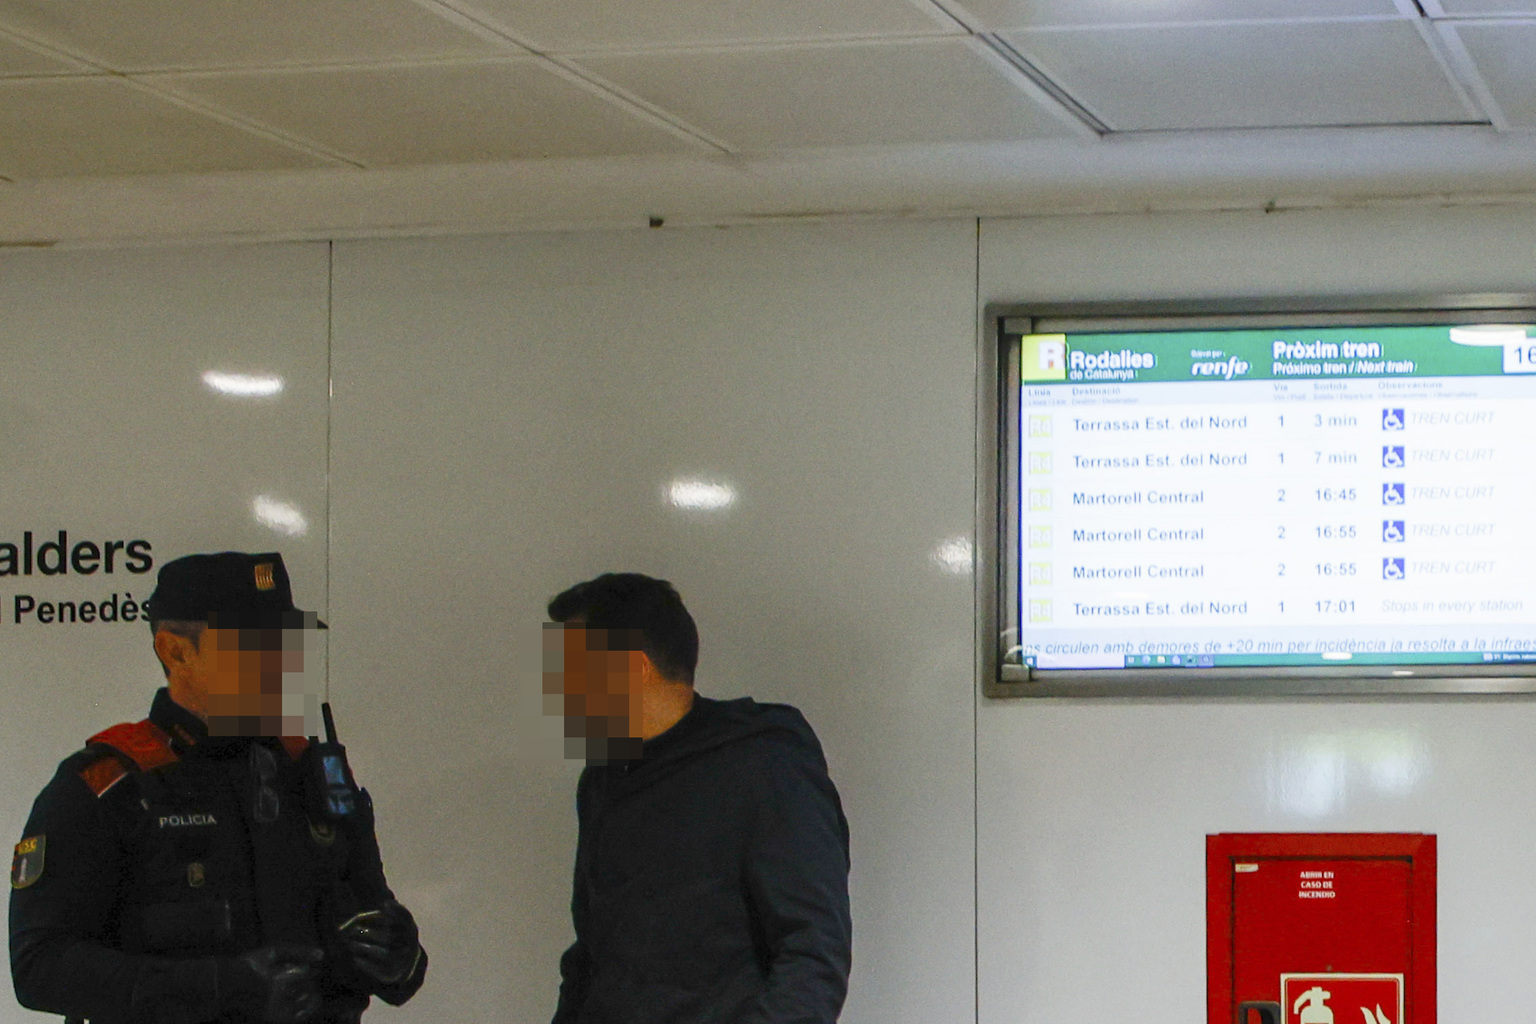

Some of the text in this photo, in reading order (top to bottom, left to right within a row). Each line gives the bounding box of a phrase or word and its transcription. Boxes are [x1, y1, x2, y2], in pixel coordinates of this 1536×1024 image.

[1070, 349, 1154, 369] Rodalies
[1272, 341, 1381, 359] Pròxim tren
[1070, 369, 1135, 381] de Catalunya
[1191, 355, 1249, 380] renfe
[1272, 361, 1322, 376] Próximo
[1324, 362, 1347, 375] tren
[1356, 361, 1385, 374] Next
[1386, 361, 1414, 374] train
[1073, 418, 1140, 431] Terrassa
[1145, 417, 1175, 431] Est.
[1180, 417, 1204, 430] del
[1209, 416, 1247, 429] Nord
[1277, 416, 1286, 428] 1
[1314, 415, 1322, 427] 3
[1328, 414, 1357, 427] min
[1411, 412, 1449, 424] TREN
[1454, 411, 1495, 424] CURT
[1073, 455, 1140, 468] Terrassa
[1145, 454, 1175, 468] Est.
[1180, 454, 1204, 467] del
[1209, 453, 1247, 466] Nord
[1277, 452, 1286, 464] 1
[1314, 452, 1322, 464] 7
[1328, 452, 1357, 464] min
[1411, 449, 1449, 461] TREN
[1454, 448, 1495, 461] CURT
[1073, 492, 1142, 506] Martorell
[1147, 492, 1205, 504] Central
[1277, 490, 1286, 502] 2
[1315, 490, 1357, 502] 16:45
[1411, 486, 1449, 498] TREN
[1454, 486, 1495, 498] CURT
[1073, 530, 1142, 543] Martorell
[1147, 529, 1205, 542] Central
[1277, 528, 1286, 540] 2
[1315, 527, 1357, 539] 16:55
[1411, 524, 1449, 536] TREN
[1454, 523, 1495, 536] CURT
[1073, 567, 1142, 580] Martorell
[1147, 566, 1205, 579] Central
[1277, 564, 1286, 576] 2
[1315, 564, 1357, 576] 16:55
[1411, 561, 1449, 573] TREN
[1454, 560, 1495, 573] CURT
[1073, 604, 1140, 618] Terrassa
[1145, 604, 1175, 618] Est.
[1180, 604, 1204, 616] del
[1209, 602, 1247, 616] Nord
[1277, 602, 1286, 614] 1
[1315, 602, 1357, 614] 17:01
[1381, 600, 1418, 614] Stops
[1423, 600, 1434, 612] in
[1438, 602, 1476, 615] every
[1479, 600, 1523, 612] station
[1045, 640, 1099, 655] circulen
[1103, 640, 1134, 654] amb
[1139, 640, 1199, 654] demores
[1205, 639, 1222, 653] de
[1226, 639, 1254, 653] +20
[1257, 640, 1284, 652] min
[1287, 641, 1312, 655] per
[1315, 638, 1386, 652] incidència
[1389, 638, 1403, 653] ja
[1408, 638, 1456, 651] resolta
[1460, 641, 1470, 651] a
[1473, 638, 1487, 651] la
[158, 814, 218, 828] POLICIA
[1323, 871, 1335, 879] EN
[1300, 880, 1333, 889] CASO DE
[1298, 890, 1336, 898] INCENDIO
